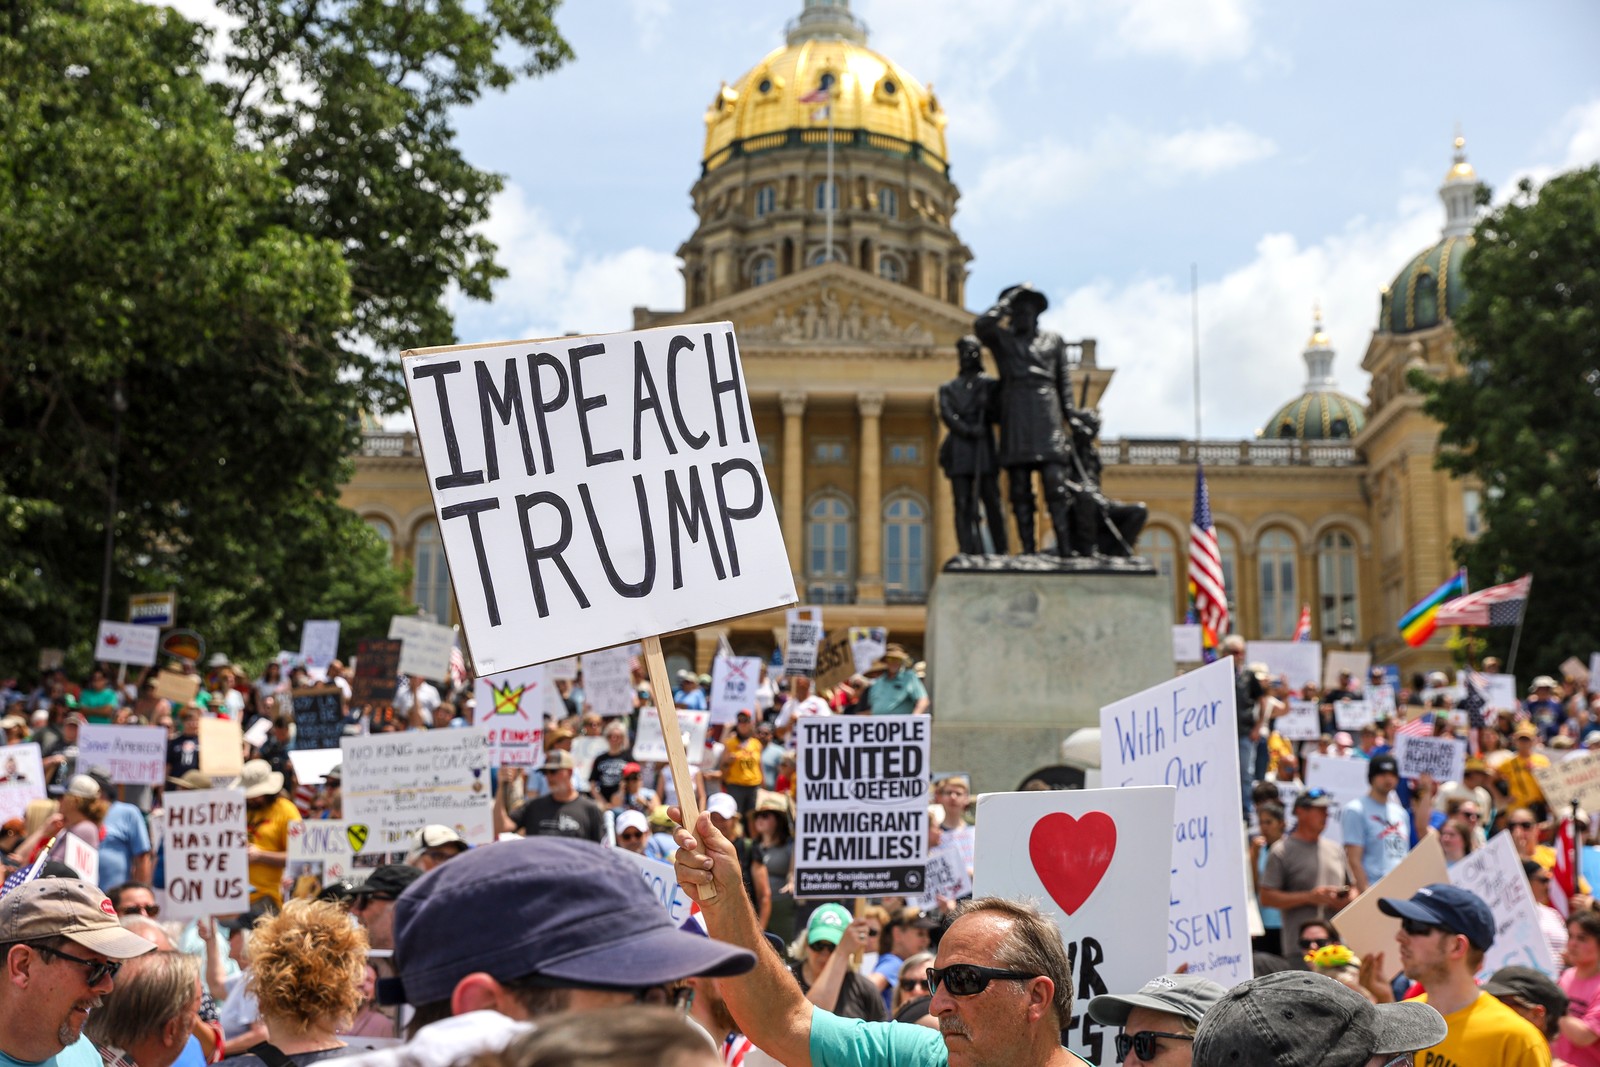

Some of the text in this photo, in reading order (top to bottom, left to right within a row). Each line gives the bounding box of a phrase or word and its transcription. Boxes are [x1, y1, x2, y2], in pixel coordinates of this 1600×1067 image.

[413, 332, 750, 490] IMPEACH
[442, 458, 763, 627] TRUMP
[804, 722, 924, 744] THE PEOPLE
[1115, 687, 1222, 765] With Fear
[108, 759, 162, 781] TRUMP
[805, 746, 922, 780] UNITED
[1165, 757, 1208, 788] Our
[805, 779, 922, 800] WILL DEFEND
[169, 801, 243, 827] HISTORY
[804, 812, 922, 833] IMMIGRANT
[173, 831, 246, 849] HAS ITS
[803, 836, 921, 861] FAMILIES!
[1174, 816, 1213, 868] acy.
[187, 853, 229, 871] EYE
[801, 871, 891, 882] Party for Socialism and
[801, 882, 842, 891] Liberation
[169, 877, 243, 904] ON US
